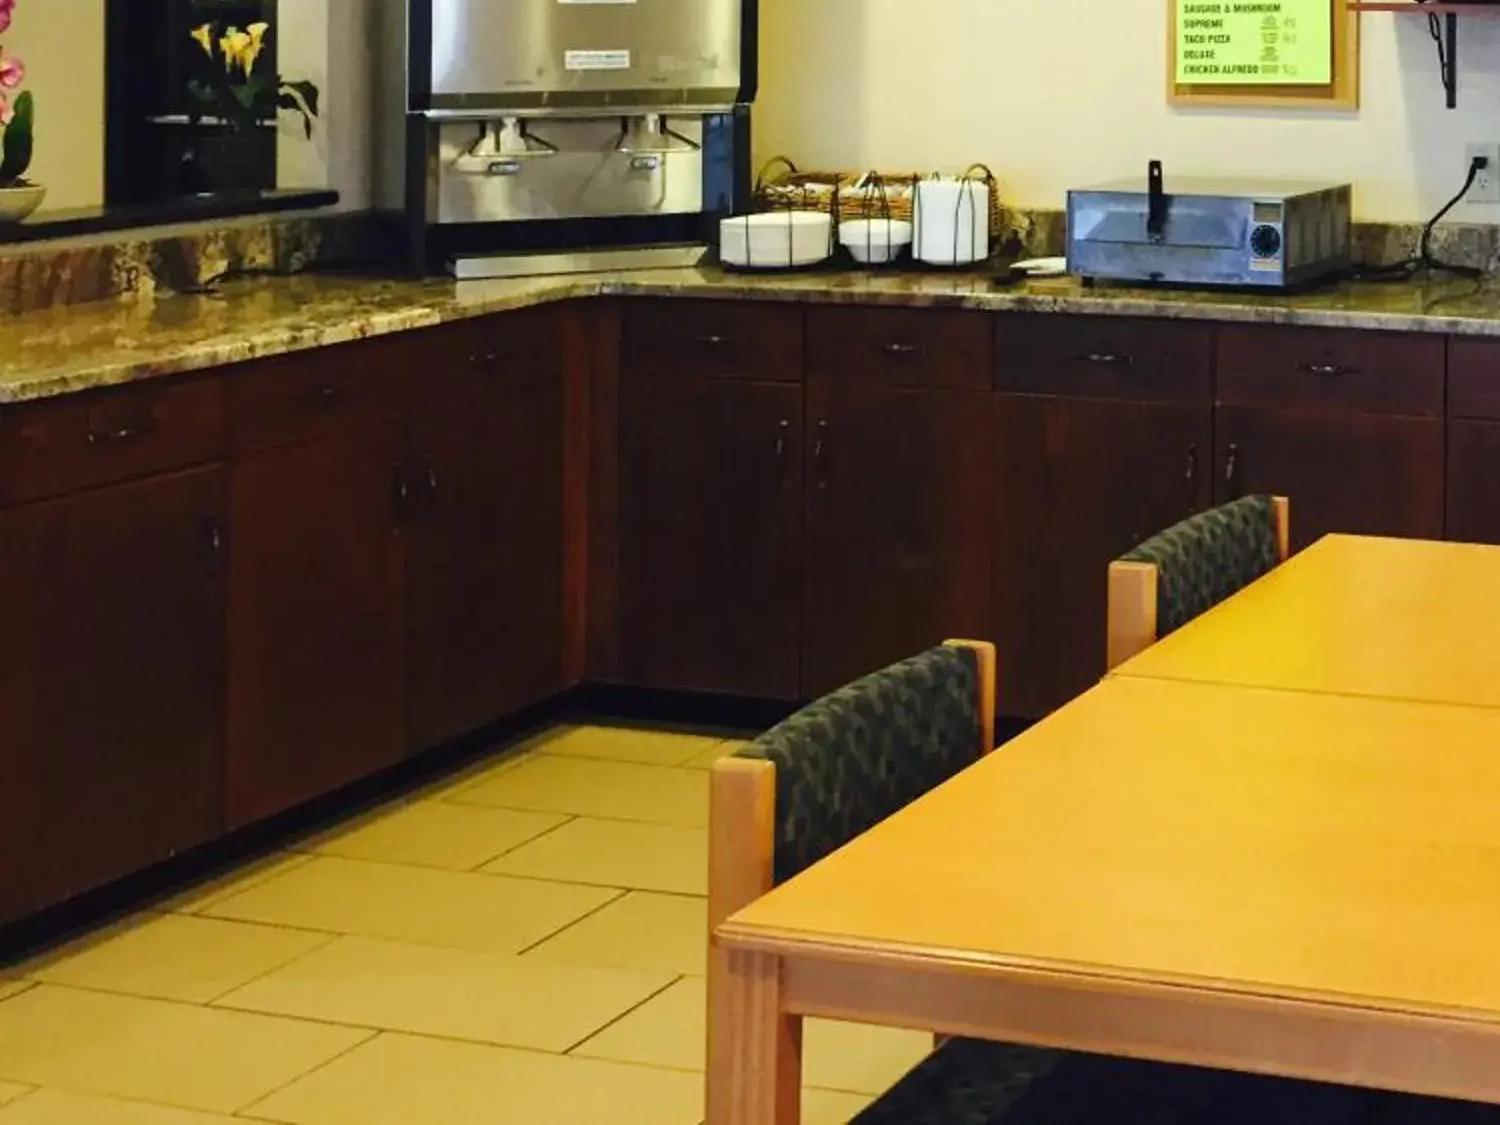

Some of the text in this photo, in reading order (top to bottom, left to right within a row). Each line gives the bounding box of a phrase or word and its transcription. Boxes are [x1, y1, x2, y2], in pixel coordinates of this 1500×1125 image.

[1184, 4, 1221, 14] SAUSAGE
[1233, 3, 1281, 13] MUSHROOM
[1184, 19, 1223, 29] SUPREME
[1184, 34, 1231, 43] TACO PIZZA
[1184, 49, 1215, 59] DELUXE
[1184, 64, 1259, 74] CHICKEN ALFREDO
